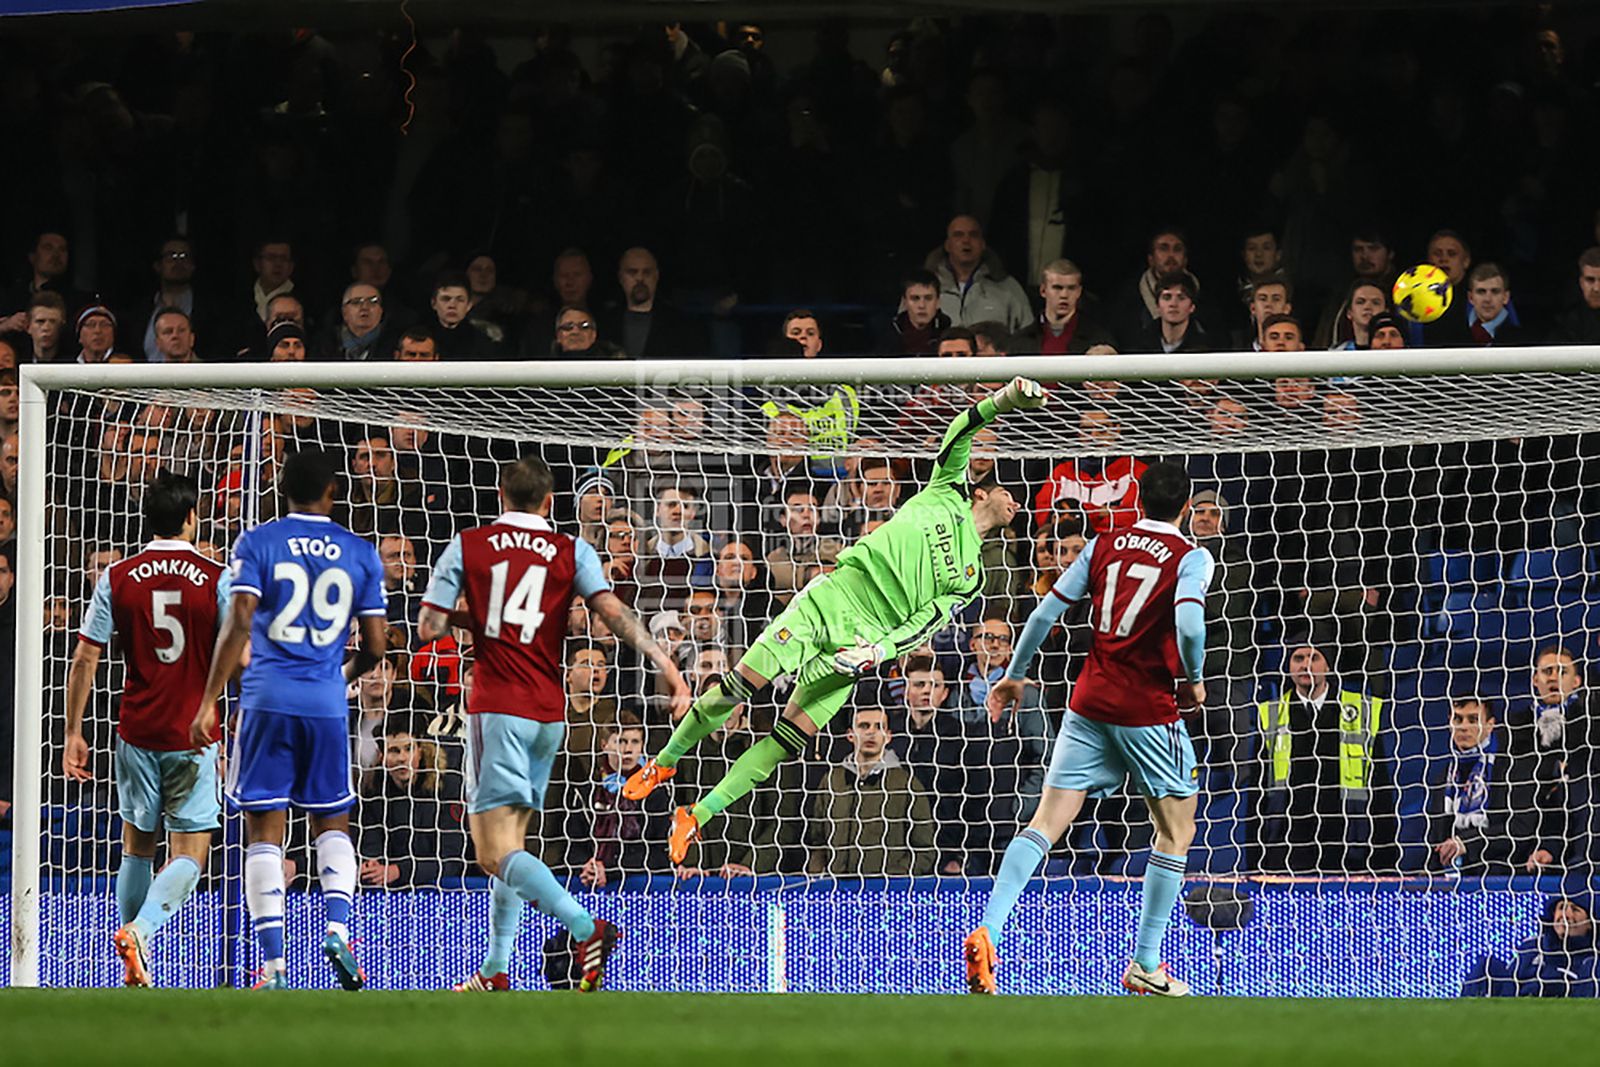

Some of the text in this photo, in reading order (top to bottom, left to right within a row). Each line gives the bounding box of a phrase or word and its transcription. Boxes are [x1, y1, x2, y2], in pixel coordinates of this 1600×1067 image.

[128, 559, 209, 587] TOMKINS
[288, 536, 342, 561] ETO'O
[487, 531, 558, 562] TAYLOR
[1113, 532, 1173, 564] O'BRIEN
[268, 562, 353, 647] 29
[484, 560, 548, 644] 14
[1099, 560, 1161, 637] 17
[151, 590, 186, 664] 5
